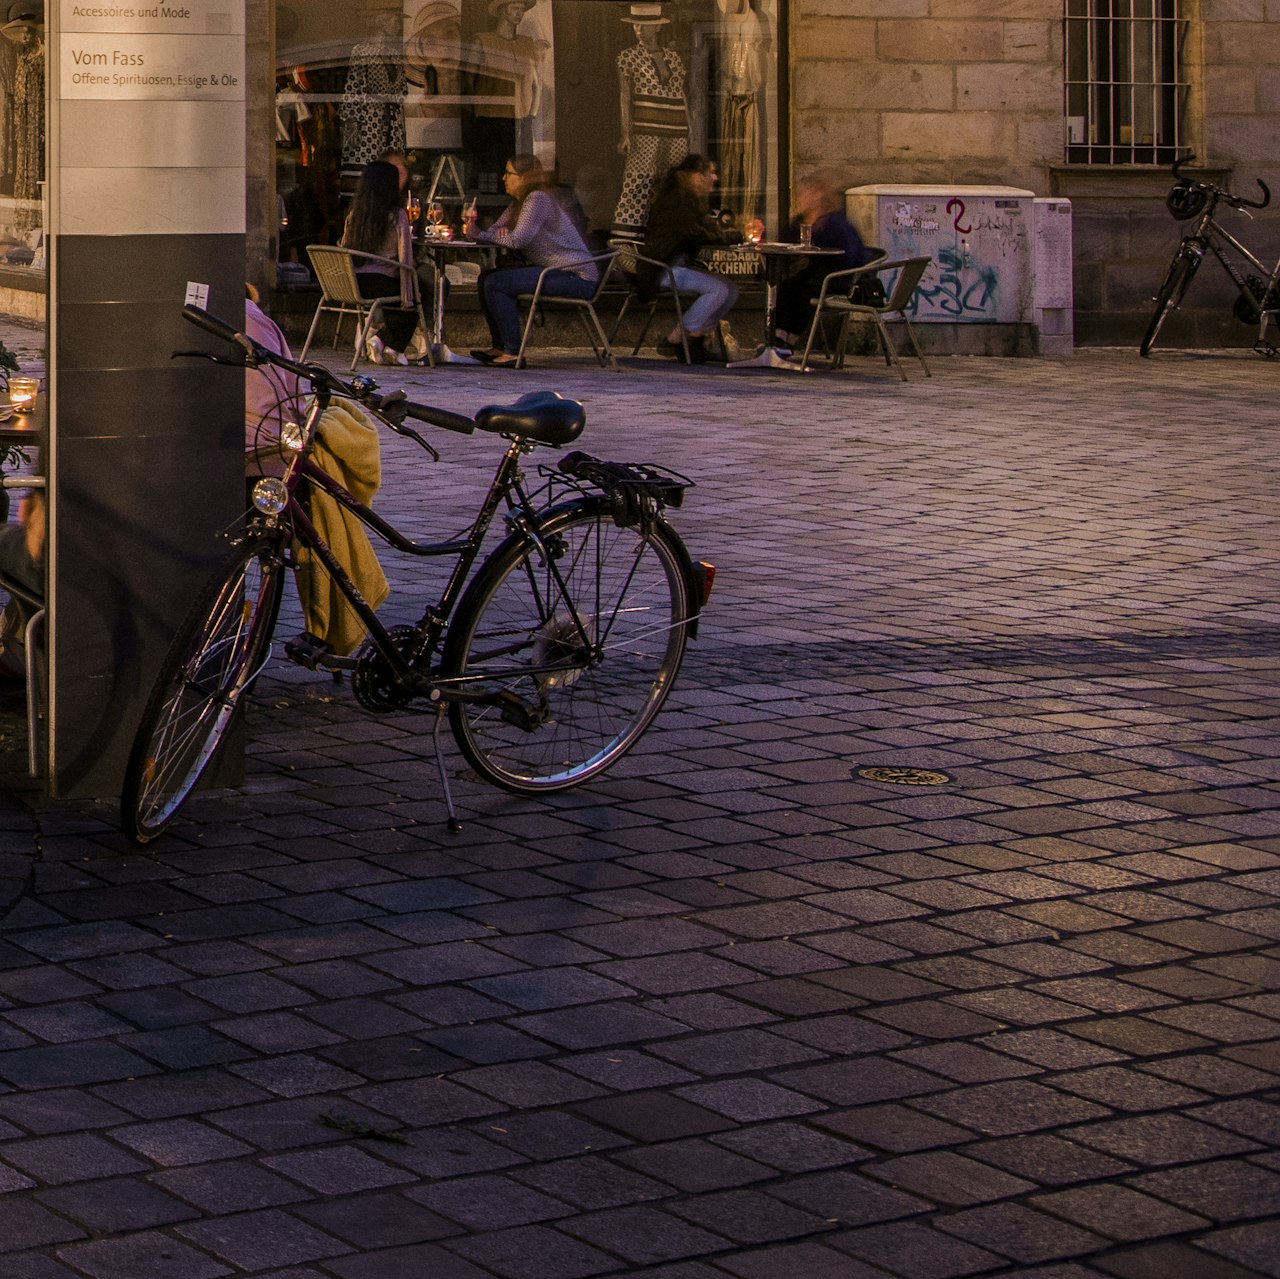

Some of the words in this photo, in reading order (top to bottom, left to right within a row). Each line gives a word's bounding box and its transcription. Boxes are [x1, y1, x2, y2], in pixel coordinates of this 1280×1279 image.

[72, 6, 135, 17] Accessoires
[138, 7, 158, 18] und
[161, 7, 190, 19] Mode
[72, 50, 107, 65] Vom
[112, 50, 144, 66] Fass
[72, 73, 110, 85] Offene
[113, 73, 176, 87] Spirituosen,
[178, 74, 208, 89] Essige
[210, 74, 219, 86] &
[221, 73, 238, 87] Öle
